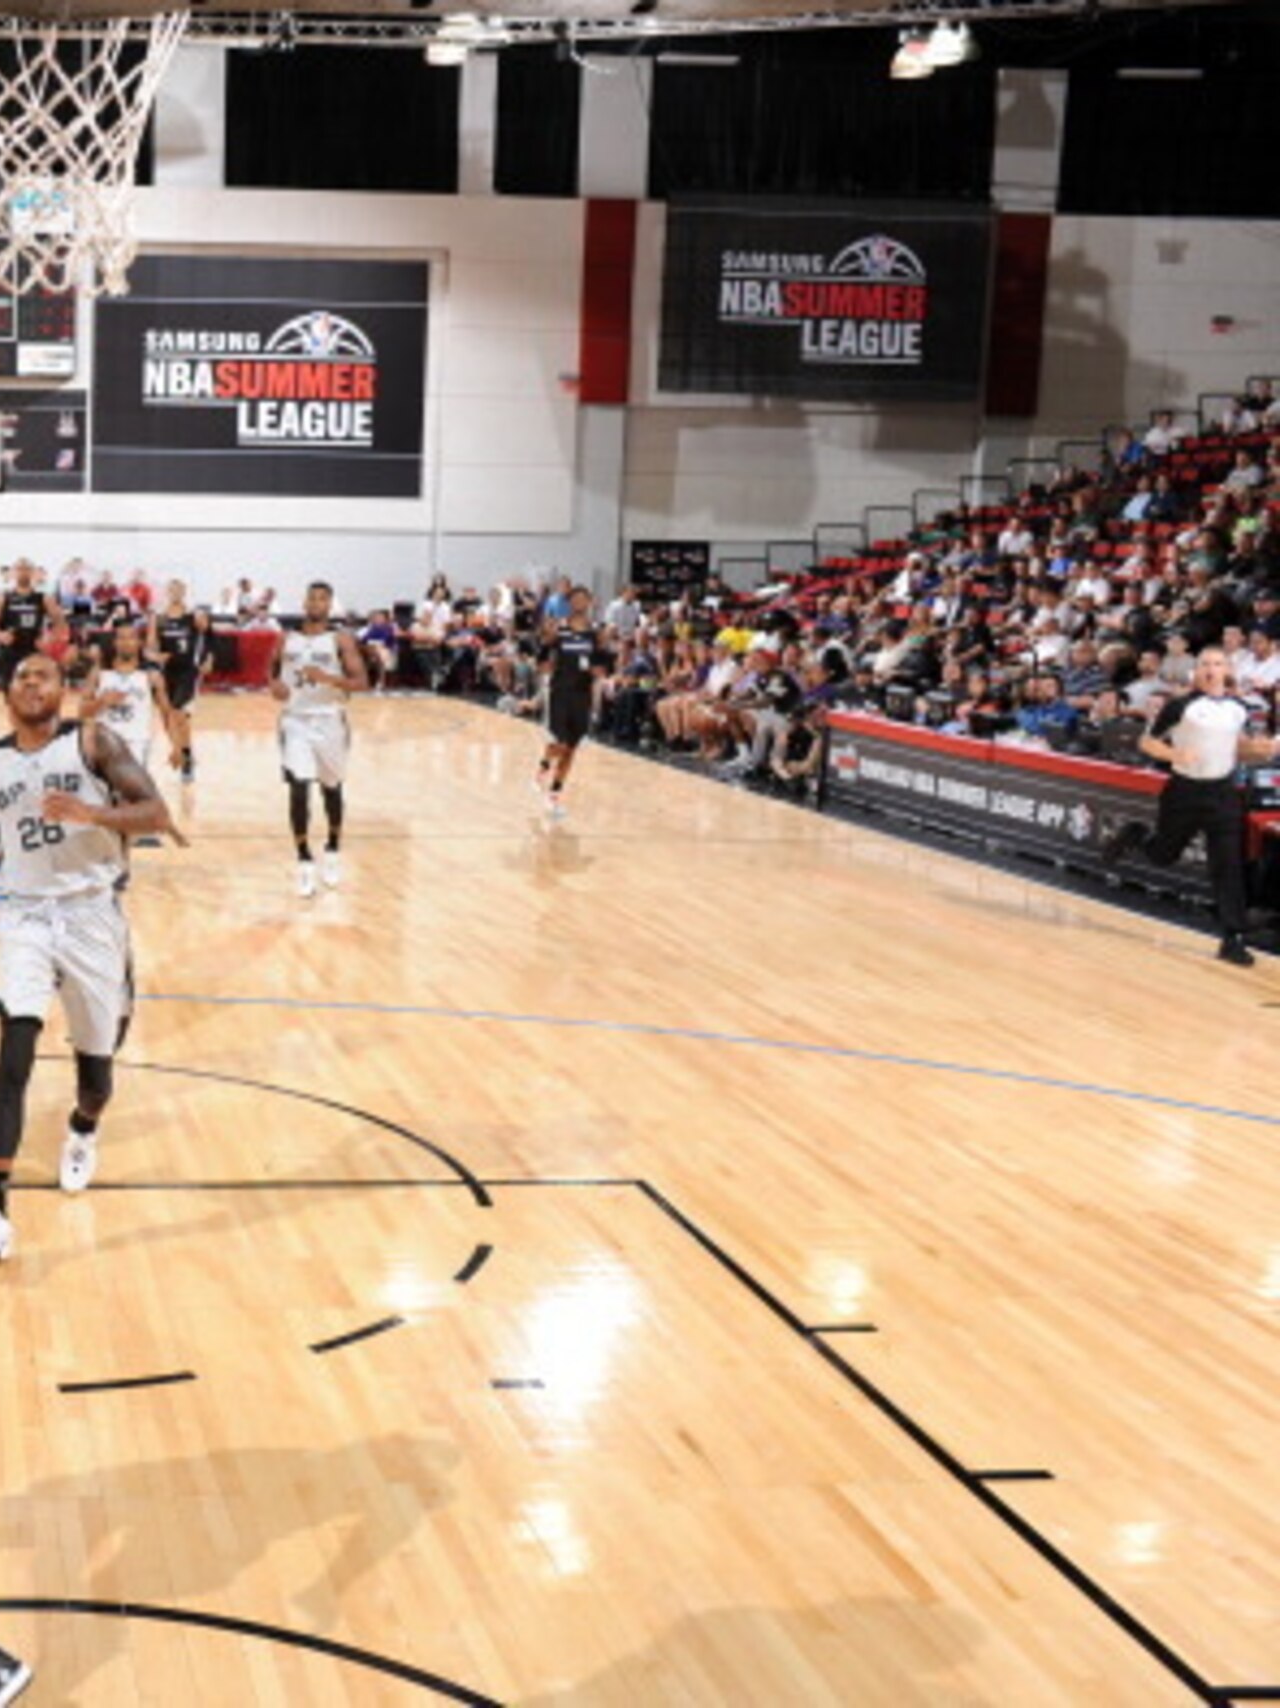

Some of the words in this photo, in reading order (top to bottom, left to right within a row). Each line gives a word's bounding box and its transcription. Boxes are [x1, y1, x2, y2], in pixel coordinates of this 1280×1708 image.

[721, 251, 823, 273] SAMSUNG
[144, 330, 261, 351] SAMSUNG
[801, 319, 922, 356] LEAGUE
[237, 401, 373, 438] LEAGUE
[17, 817, 65, 852] 26
